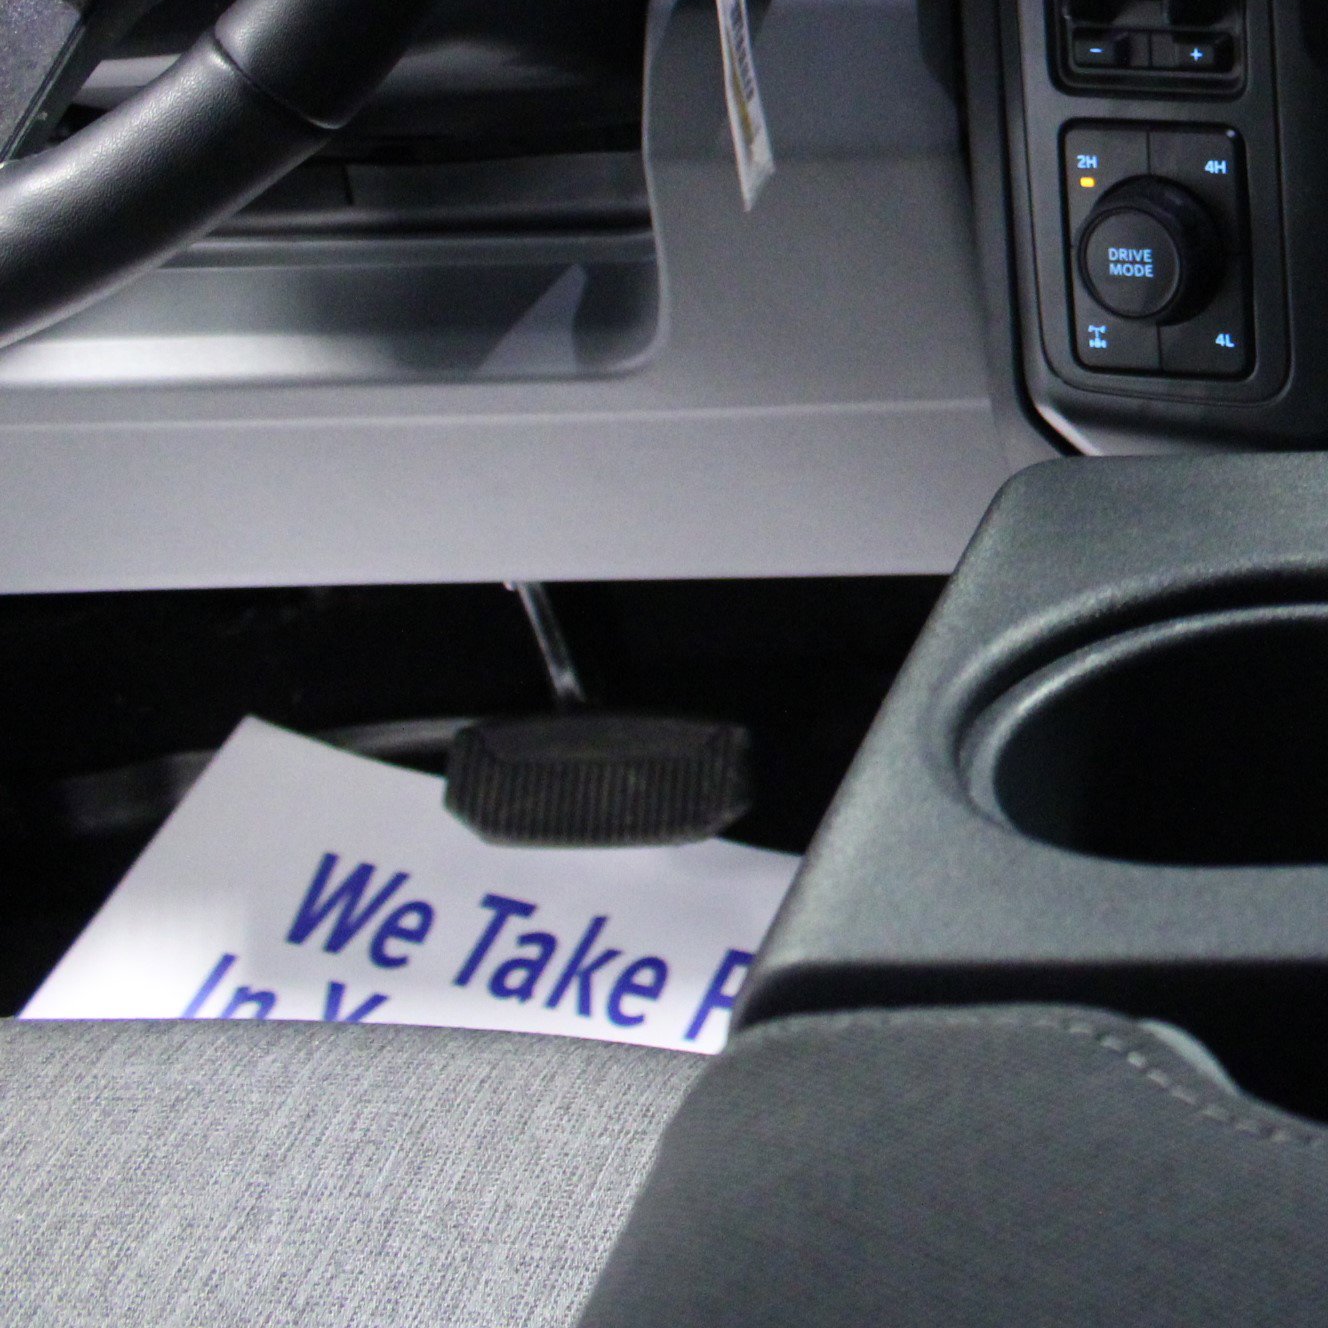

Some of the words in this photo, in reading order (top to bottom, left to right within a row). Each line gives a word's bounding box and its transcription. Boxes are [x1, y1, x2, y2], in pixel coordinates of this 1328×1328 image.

[1077, 155, 1098, 169] 2H
[1204, 160, 1228, 174] 4H
[1108, 248, 1152, 263] DRIVE
[1109, 264, 1153, 277] MODE
[1215, 333, 1235, 347] 4L
[286, 853, 434, 969] We
[453, 893, 669, 1028] Take
